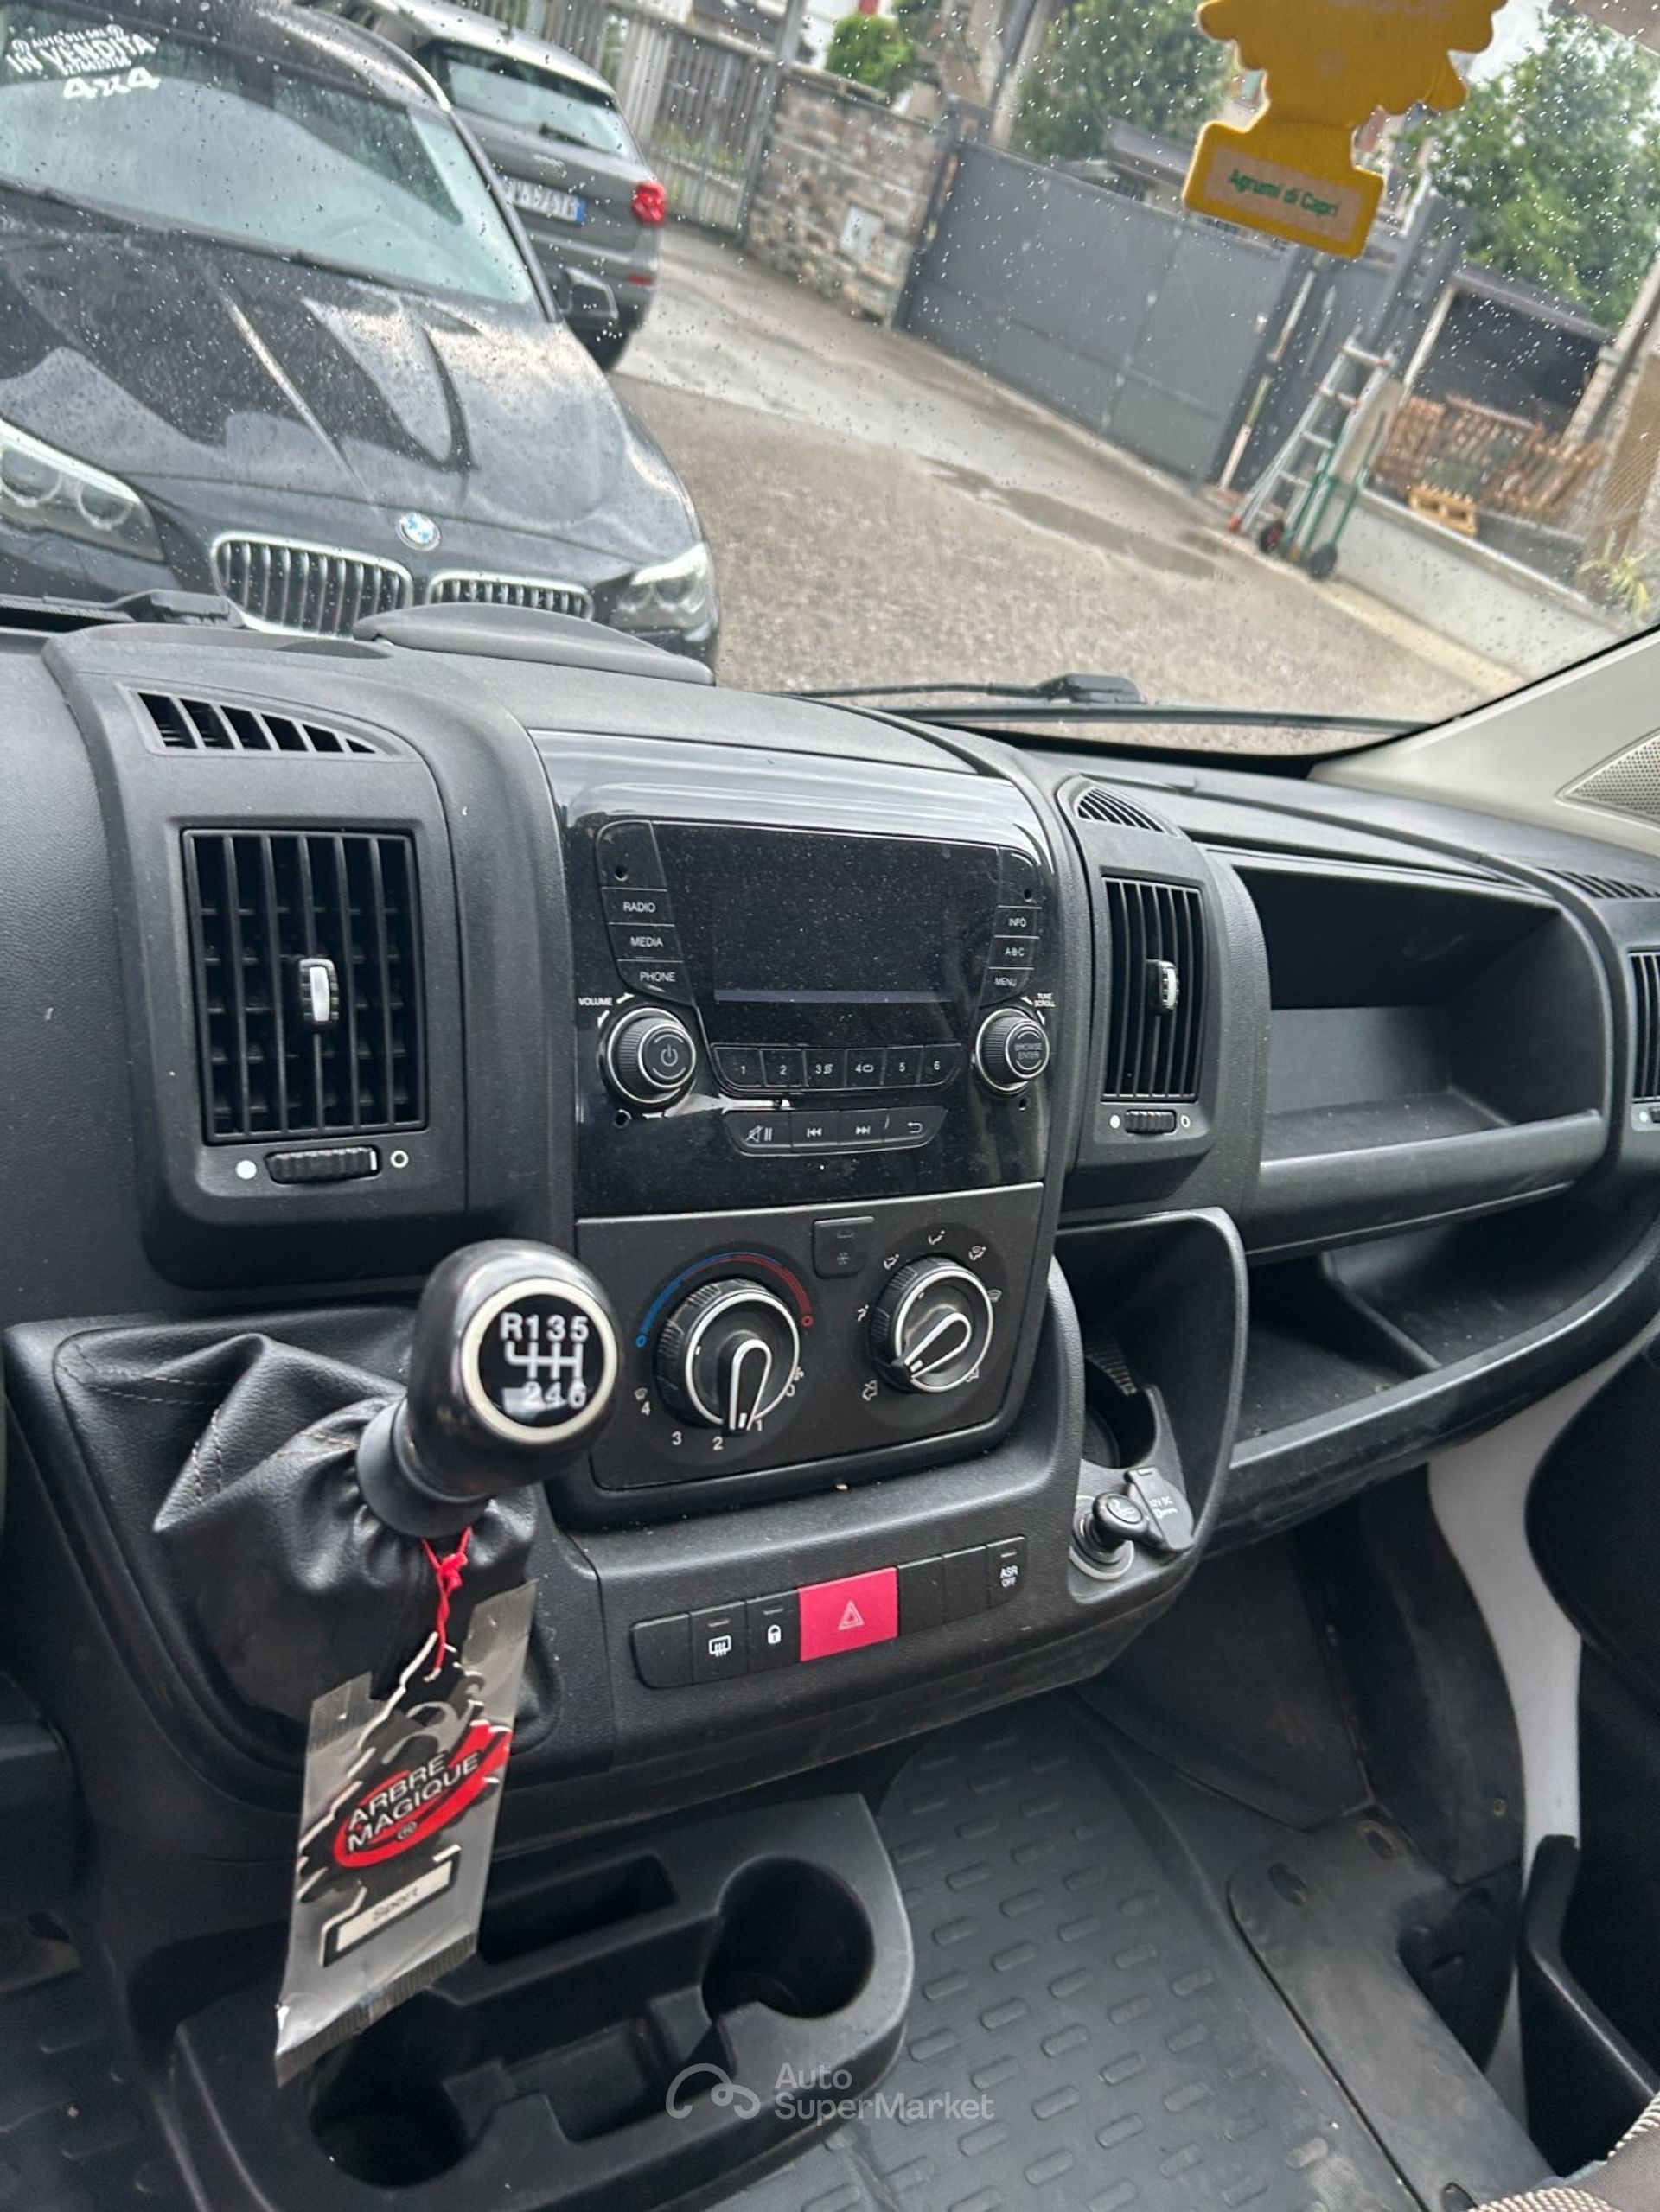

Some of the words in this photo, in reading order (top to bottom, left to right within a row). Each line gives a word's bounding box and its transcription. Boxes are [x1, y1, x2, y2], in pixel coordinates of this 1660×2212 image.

[6, 51, 43, 73] IN
[39, 33, 156, 76] VENDITA
[1229, 169, 1284, 199] Agrumi
[1283, 187, 1300, 204] di
[1300, 192, 1342, 218] Capri
[623, 902, 655, 914] RADIO
[1008, 917, 1027, 928] INFO
[630, 935, 663, 947] MEDIA
[1005, 947, 1025, 957] ABC
[640, 971, 675, 983] PHONE
[995, 977, 1017, 987] MENU
[578, 998, 613, 1006] VOLUME
[740, 1065, 746, 1074] 1
[780, 1065, 788, 1074] 2
[815, 1064, 822, 1074] 3
[855, 1064, 863, 1074] 4
[899, 1062, 906, 1072] 5
[933, 1061, 941, 1070] 6
[500, 1312, 523, 1340] R
[525, 1314, 540, 1340] 1
[546, 1314, 566, 1342] 3
[571, 1316, 589, 1342] 5
[522, 1381, 543, 1408] 2
[545, 1381, 564, 1406] 4
[568, 1380, 587, 1409] 6
[641, 1401, 651, 1415] 4
[672, 1431, 682, 1445] 3
[712, 1437, 723, 1450] 2
[1000, 1565, 1018, 1578] ASR
[1002, 1577, 1016, 1588] OFF
[348, 1753, 449, 1831] ARBRE
[348, 1754, 482, 1852] MAGIQUE
[371, 1886, 421, 1922] Sport
